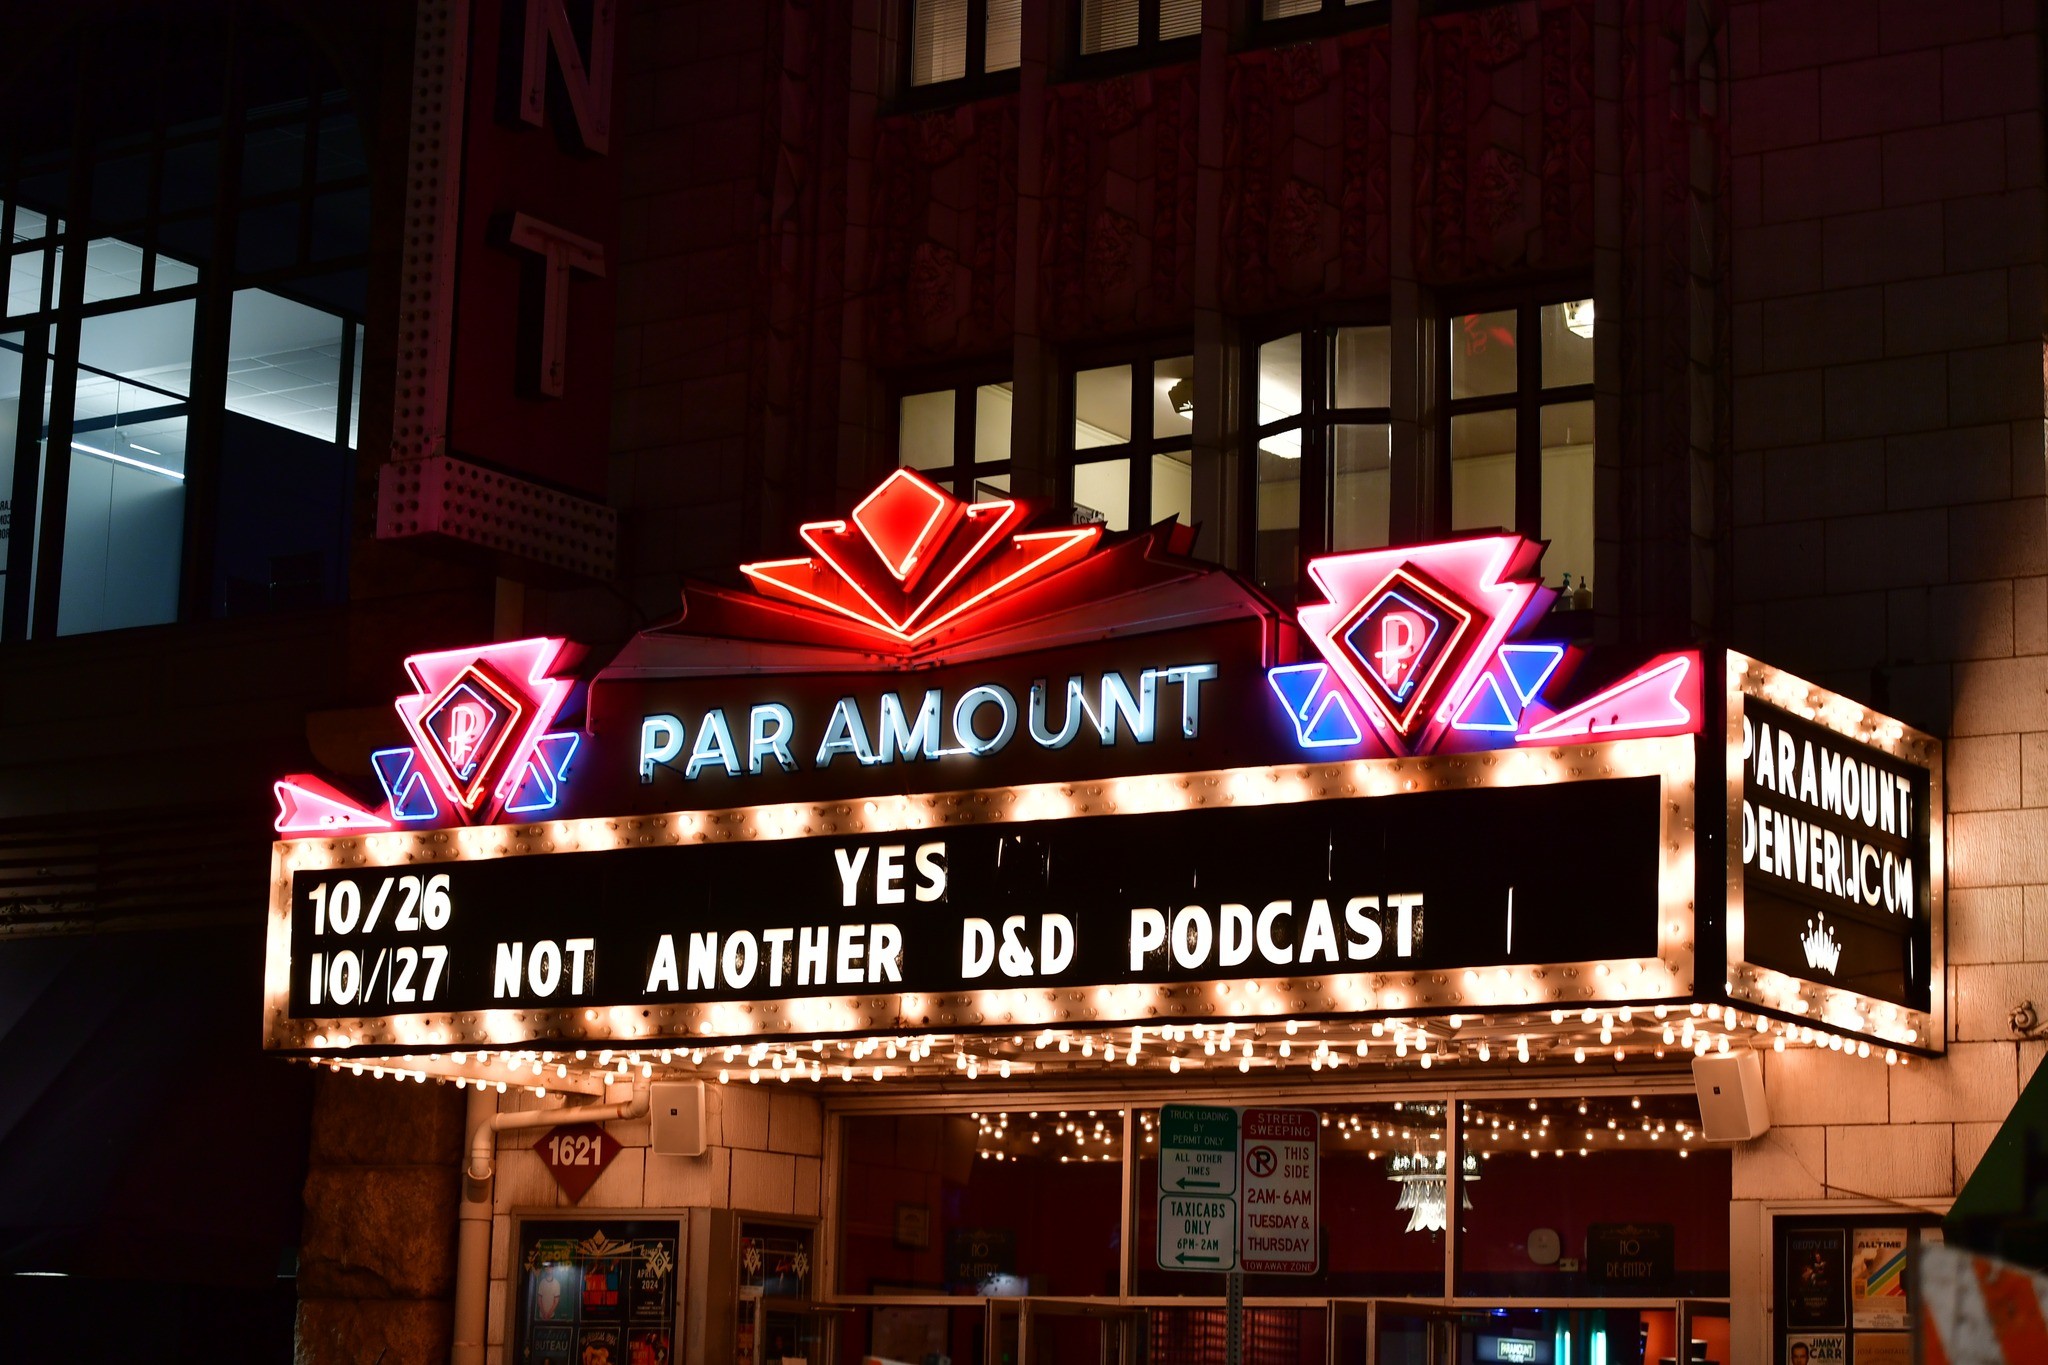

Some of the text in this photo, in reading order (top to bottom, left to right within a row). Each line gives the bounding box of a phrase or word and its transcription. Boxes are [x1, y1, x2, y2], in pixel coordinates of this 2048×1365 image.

[640, 663, 1219, 785] PARAMOUNT
[834, 841, 946, 907] YES
[308, 873, 451, 936] 10/26
[493, 892, 1424, 999] NOT ANOTHER D&D PODCAST
[309, 945, 449, 1006] 10/27
[1170, 1110, 1229, 1122] TRUCK LOADING
[1258, 1113, 1303, 1125] STREET
[1193, 1123, 1204, 1133] BY
[1250, 1124, 1311, 1137] SWEEPING
[1173, 1134, 1224, 1146] PERMIT ONLY
[548, 1135, 602, 1166] 1621
[1175, 1153, 1222, 1163] ALL OTHER
[1284, 1146, 1309, 1160] THIS
[1187, 1166, 1210, 1175] TIMES
[1284, 1164, 1310, 1179] SIDE
[1171, 1201, 1225, 1218] TAXICABS
[1184, 1219, 1211, 1235] ONLY
[1247, 1214, 1310, 1230] TUESDAY &
[971, 1243, 989, 1258] NO
[1247, 1237, 1310, 1252] THURSDAY
[1619, 1239, 1640, 1256] NO
[1245, 1261, 1312, 1272] TOW AWAY ZONE
[1606, 1261, 1654, 1278] RE-ENTRY
[641, 1280, 659, 1290] 2024
[535, 1340, 569, 1351] BUTEAU
[1809, 1338, 1842, 1348] JIMMY
[1809, 1348, 1842, 1359] CARR
